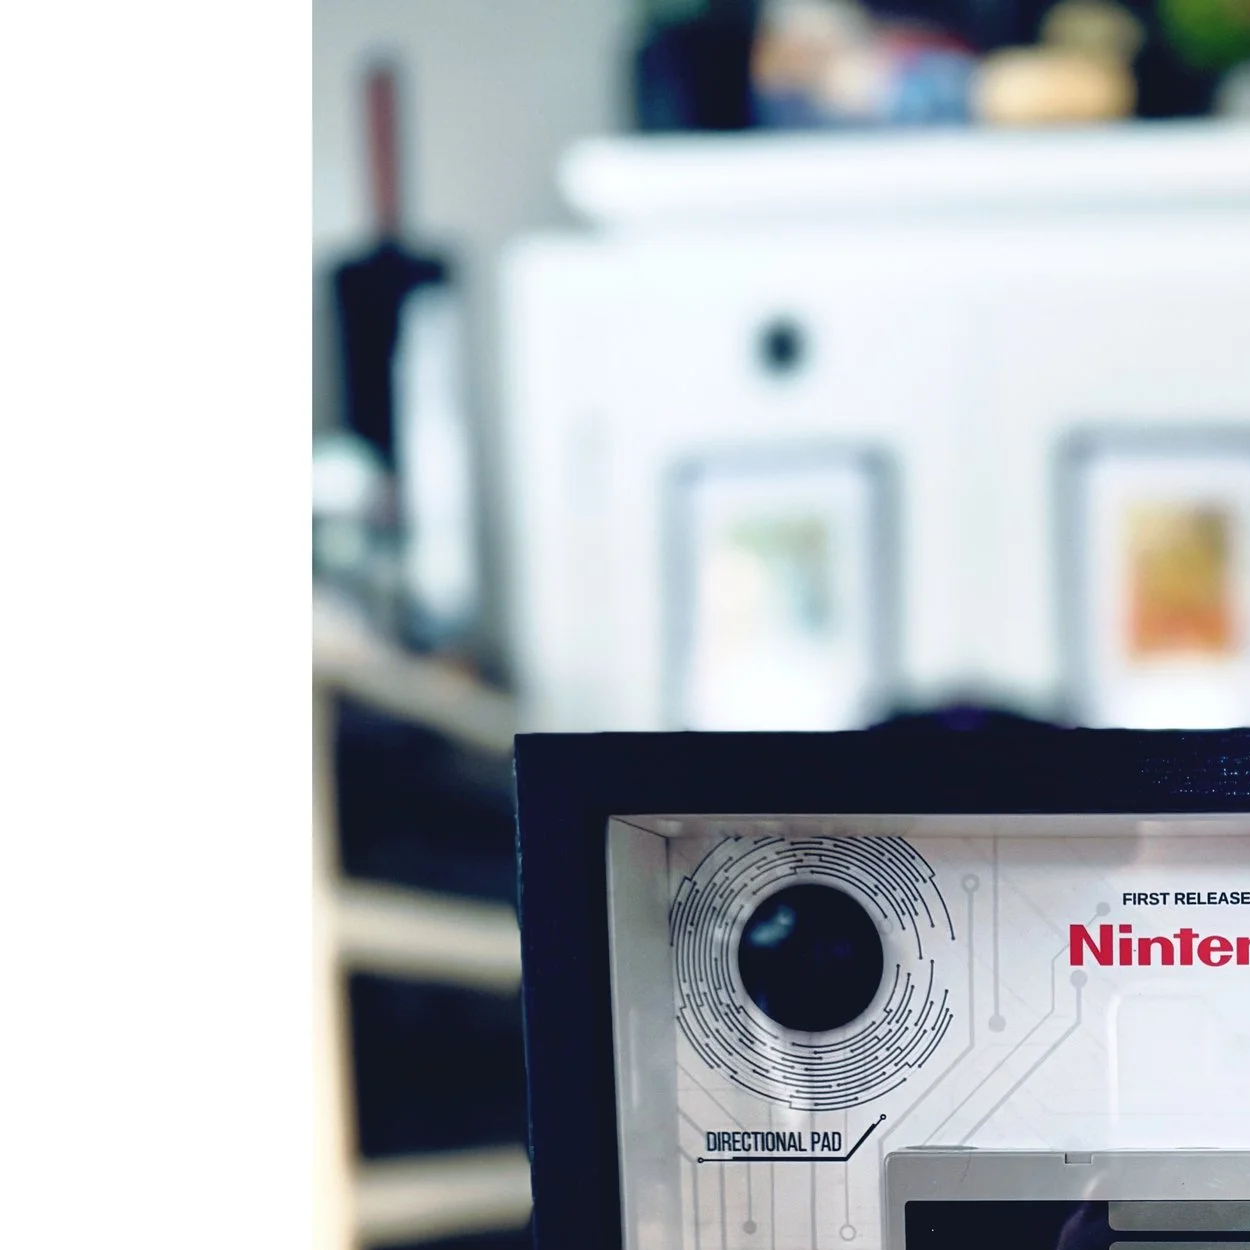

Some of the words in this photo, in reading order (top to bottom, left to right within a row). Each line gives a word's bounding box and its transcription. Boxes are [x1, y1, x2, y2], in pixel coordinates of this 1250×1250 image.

[1122, 891, 1170, 906] FIRST
[706, 1131, 807, 1152] DIRECTIONAL
[811, 1131, 842, 1151] PAD
